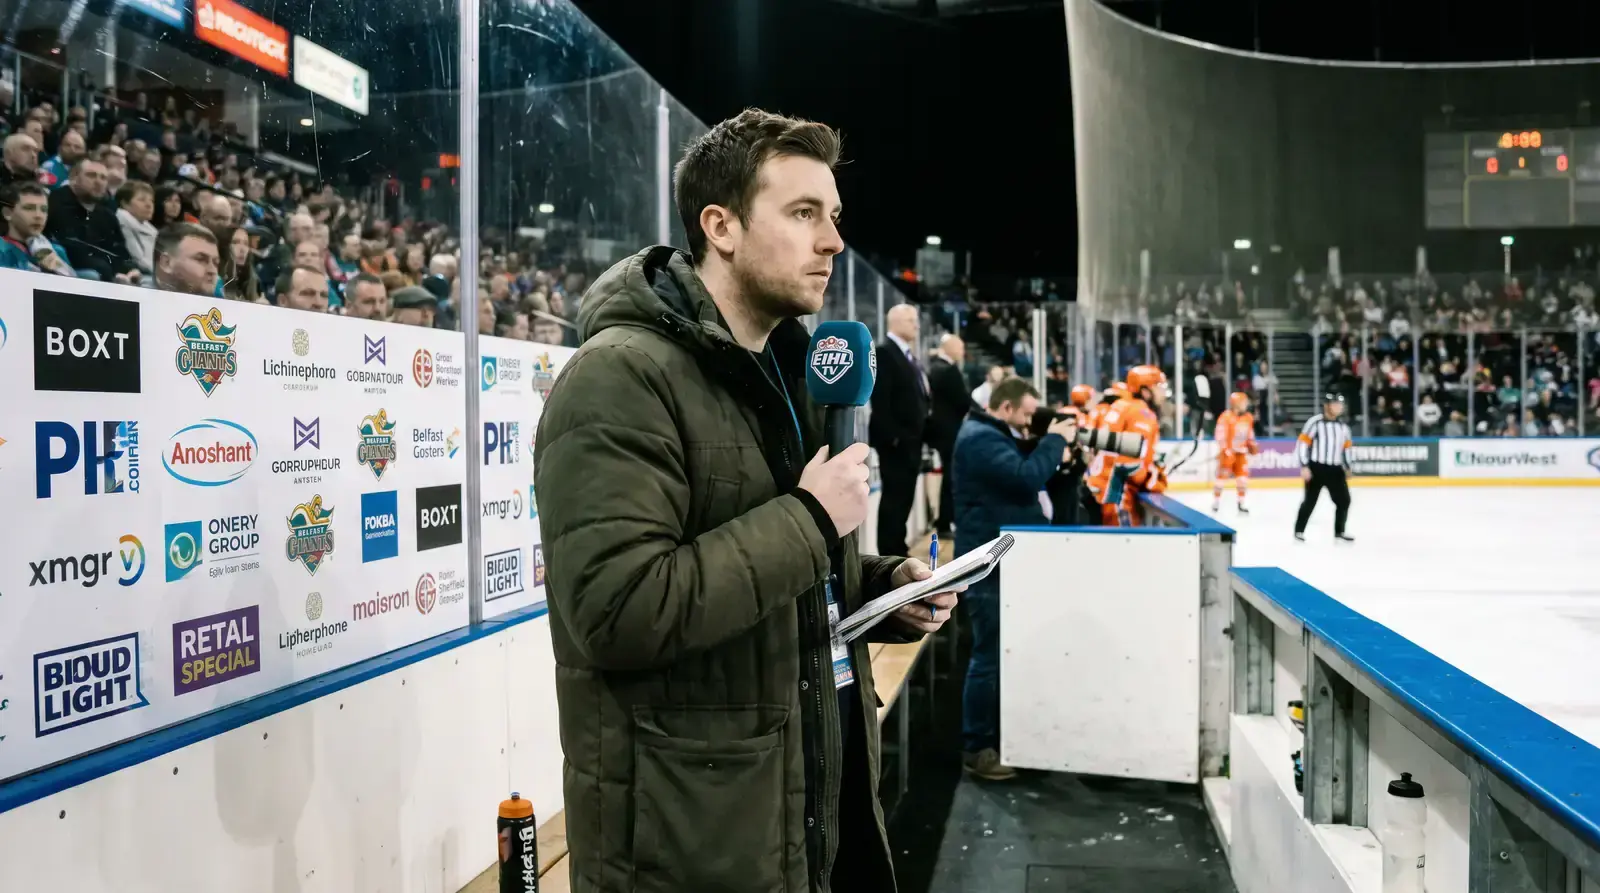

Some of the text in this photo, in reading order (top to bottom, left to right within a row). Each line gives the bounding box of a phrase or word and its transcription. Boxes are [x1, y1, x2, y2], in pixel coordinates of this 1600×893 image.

[46, 326, 129, 360] BOXT
[191, 342, 225, 352] BELFAST
[176, 346, 238, 377] GIANTS
[812, 352, 851, 366] EIHL
[822, 366, 839, 376] TV
[413, 428, 443, 442] Belfast
[171, 441, 252, 465] Anoshant
[357, 440, 396, 465] GIANTS
[421, 504, 458, 529] BOXT
[482, 499, 511, 519] xmgr
[208, 514, 259, 535] ONERY
[297, 527, 324, 537] BELFAST
[209, 533, 260, 554] GROUP
[286, 530, 335, 562] GIANTS
[29, 551, 113, 588] xmgr
[487, 571, 519, 595] LIGHT
[181, 616, 255, 659] RETAL
[279, 621, 348, 650] Lipherphone
[182, 647, 255, 685] SPECIAL
[44, 673, 131, 722] LIGHT
